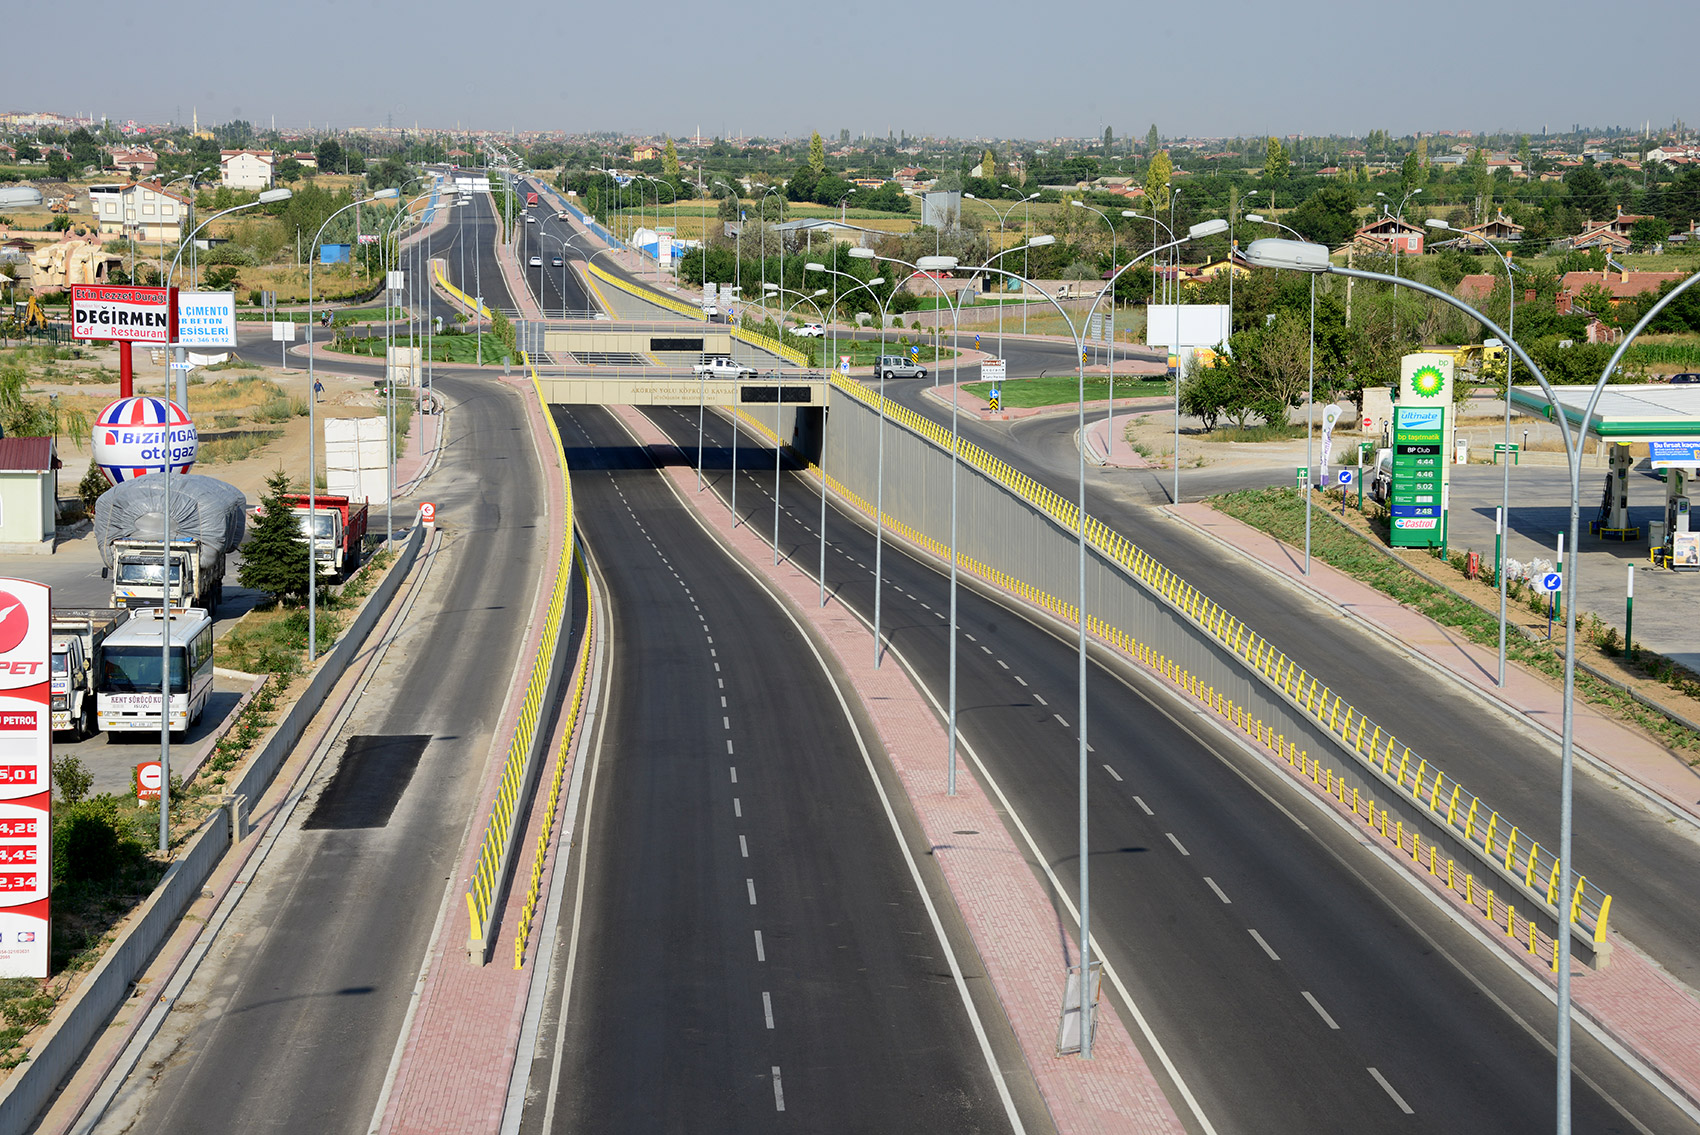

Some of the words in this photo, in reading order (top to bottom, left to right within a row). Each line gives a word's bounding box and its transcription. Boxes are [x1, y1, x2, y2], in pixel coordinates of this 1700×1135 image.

[76, 289, 97, 301] Et'in
[99, 290, 132, 301] Lezzet
[76, 306, 167, 327] DEĞİRMEN
[111, 326, 167, 339] Restaurant
[1438, 359, 1449, 367] bp
[1401, 411, 1438, 420] ultimate
[1397, 433, 1407, 441] bp
[141, 446, 195, 461] otogaz
[1407, 446, 1416, 454] BP
[1416, 470, 1434, 478] 4.46
[1415, 507, 1433, 515] 2.48
[1405, 519, 1434, 529] Castrol
[111, 696, 128, 704] KENT
[128, 695, 153, 704] SÜRÜCÜ
[3, 716, 36, 726] PETROL
